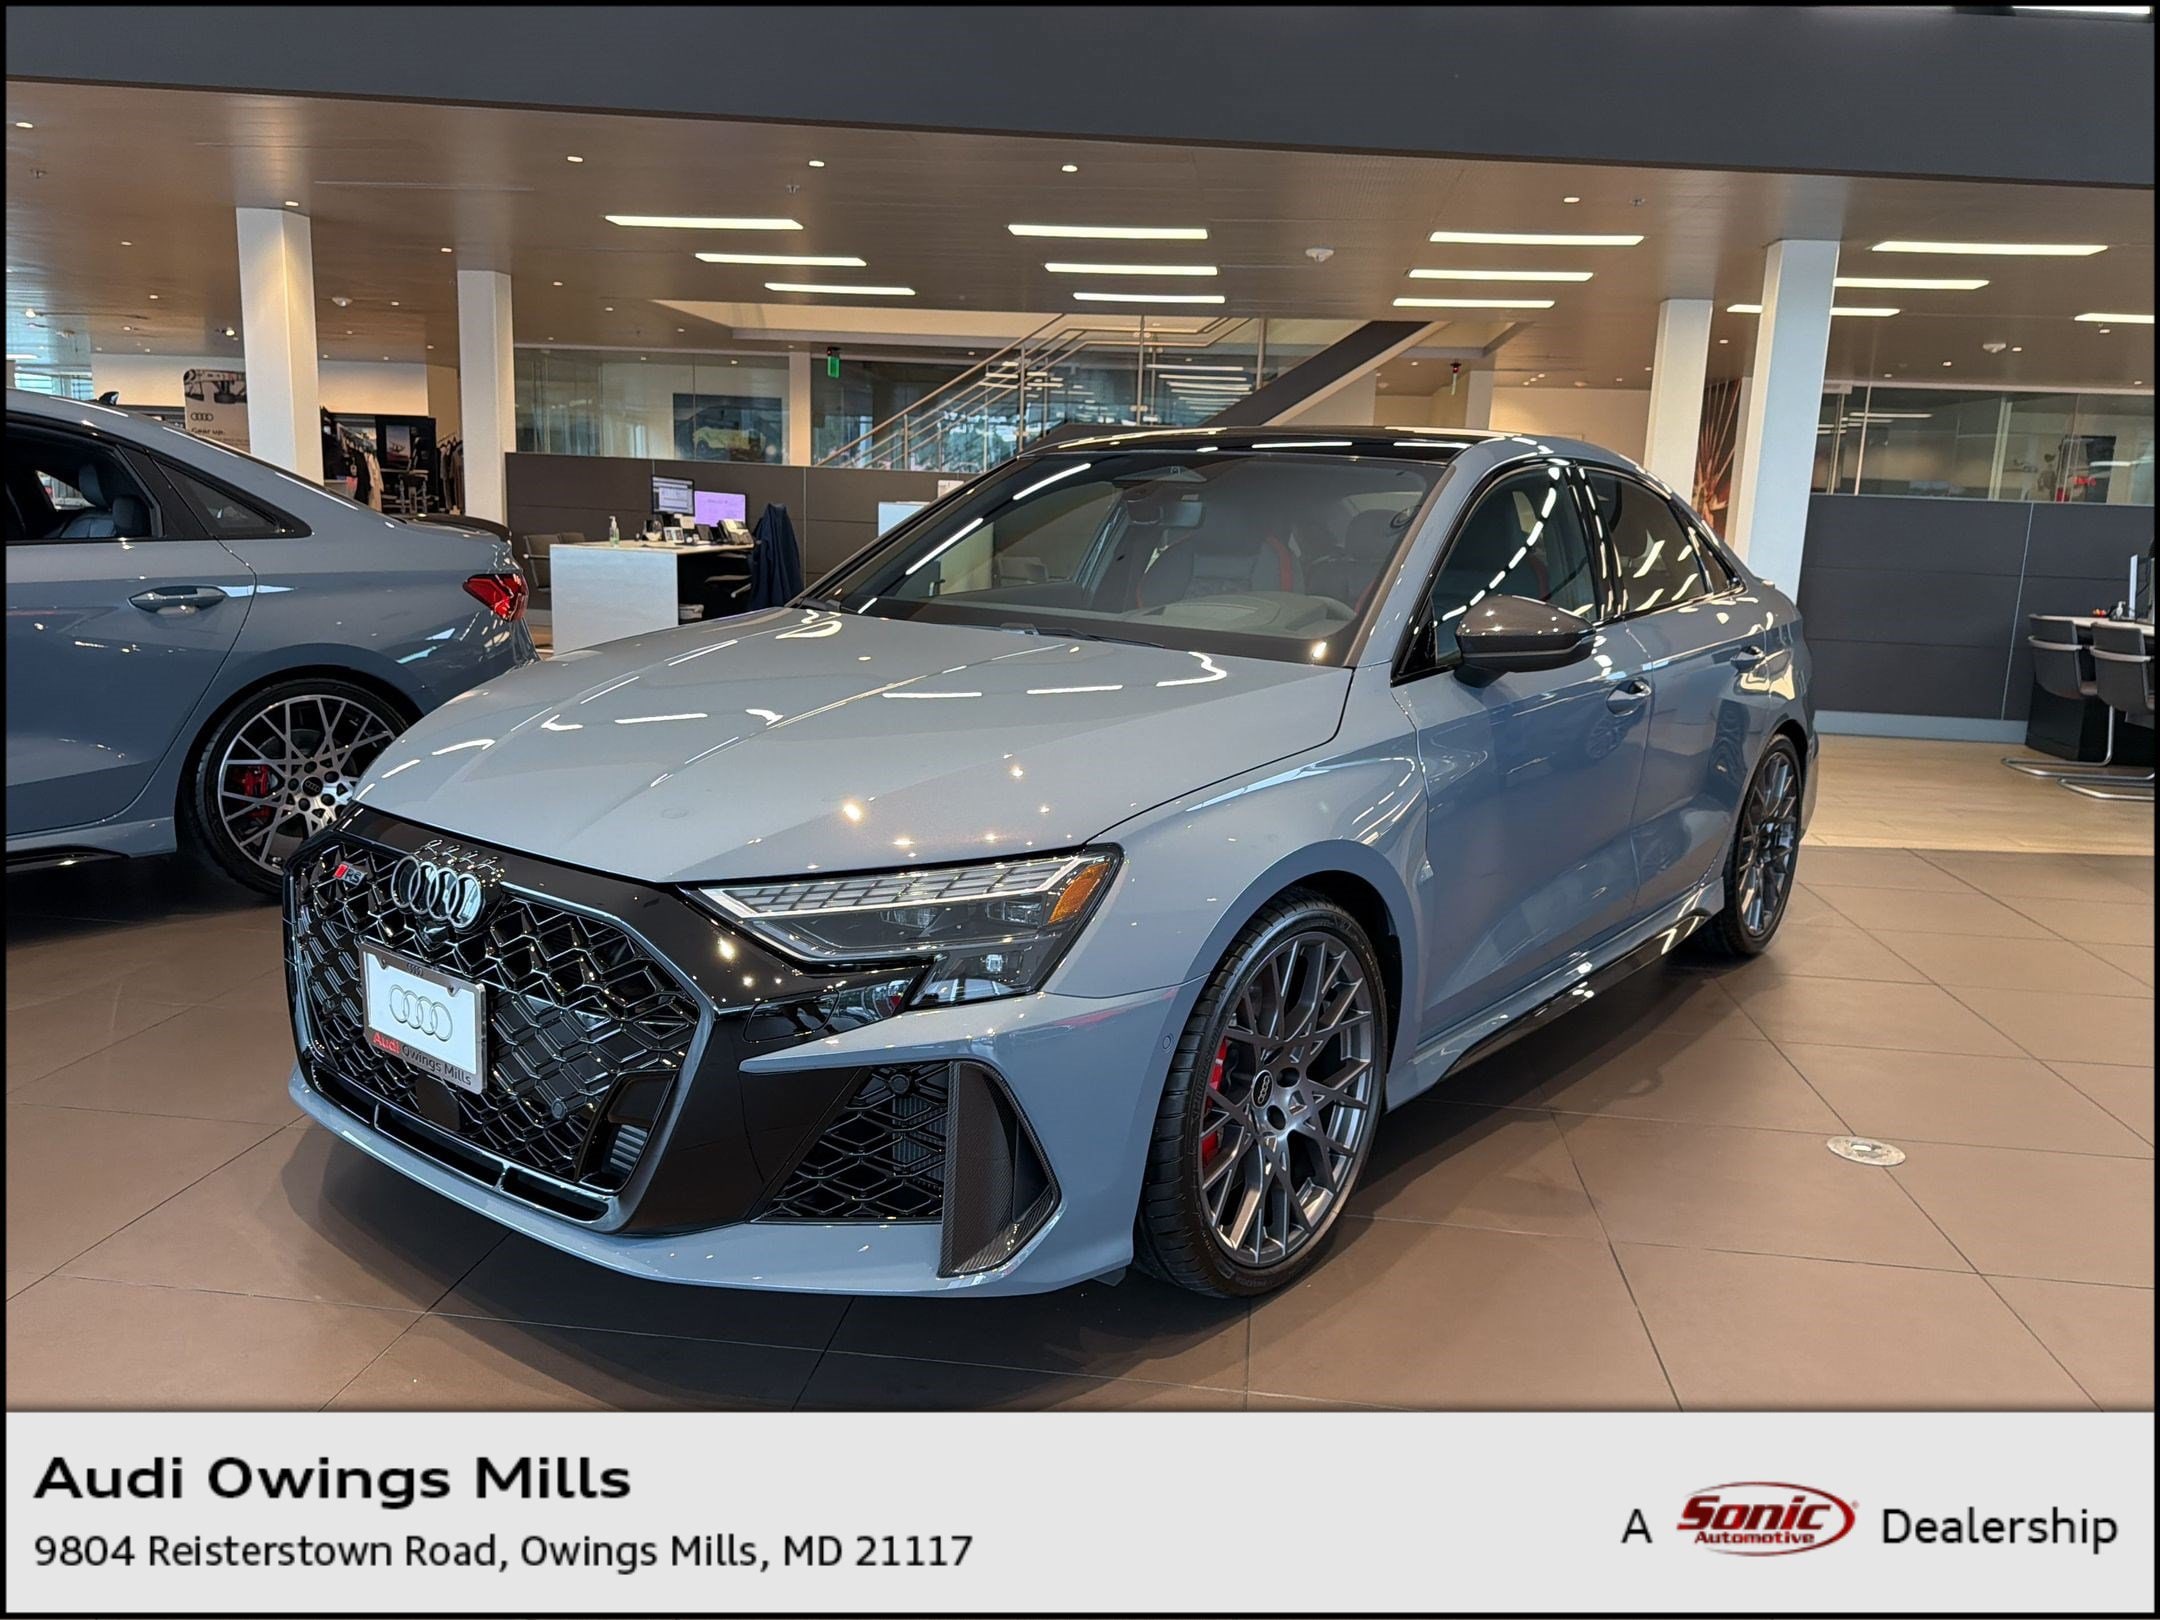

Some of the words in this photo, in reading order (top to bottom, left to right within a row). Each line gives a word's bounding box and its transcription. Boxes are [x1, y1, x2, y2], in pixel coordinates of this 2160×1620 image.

[372, 1032, 401, 1054] Audi
[402, 1046, 441, 1071] Owings
[444, 1062, 472, 1086] Mills
